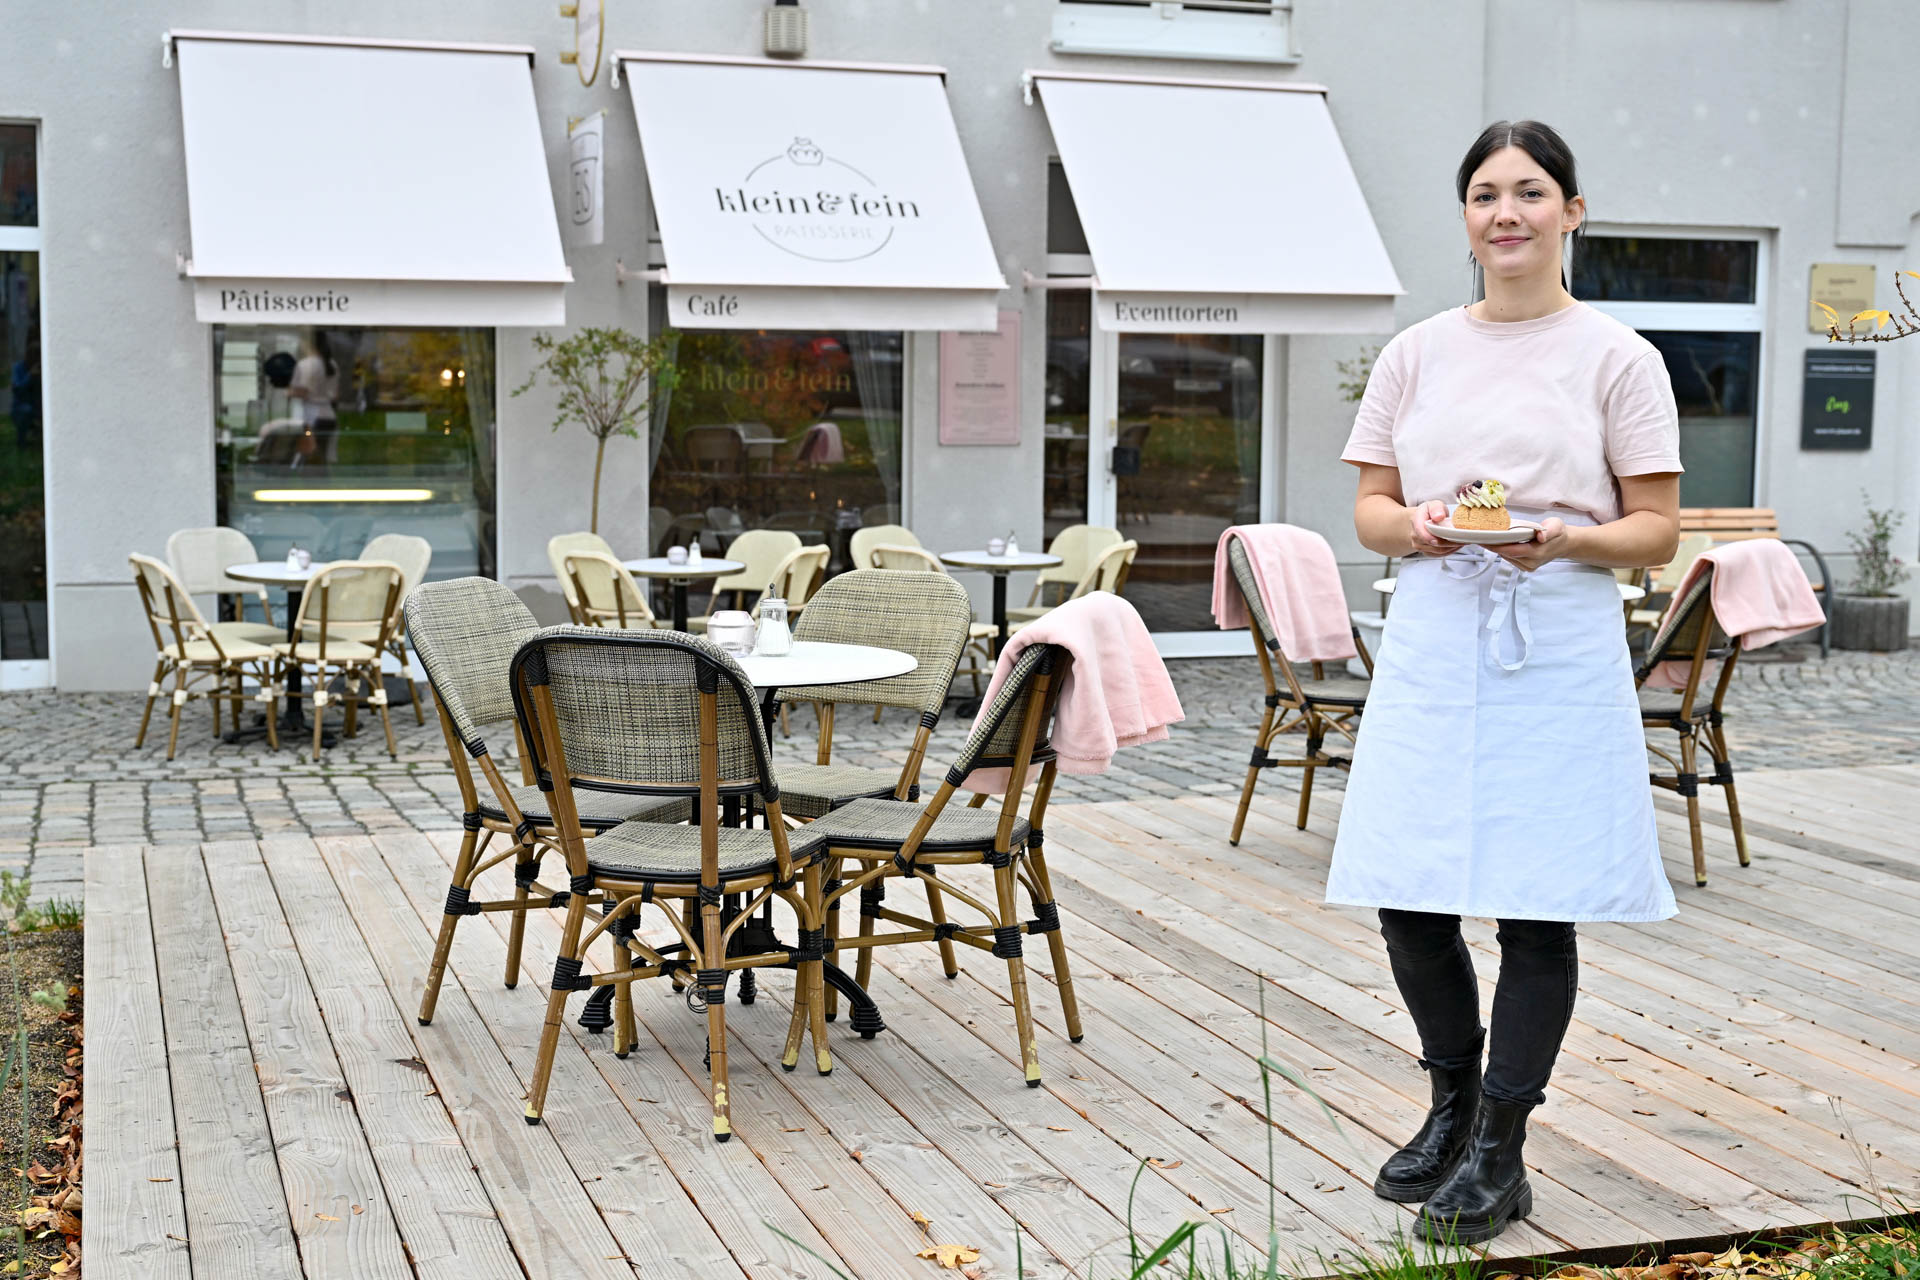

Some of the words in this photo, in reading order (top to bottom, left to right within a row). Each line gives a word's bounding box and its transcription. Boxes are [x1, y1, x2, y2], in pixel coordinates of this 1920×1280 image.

[714, 186, 921, 219] klein&fein
[220, 289, 350, 312] Pâtisserie
[687, 294, 739, 317] Café
[1114, 302, 1240, 323] Eventtorten
